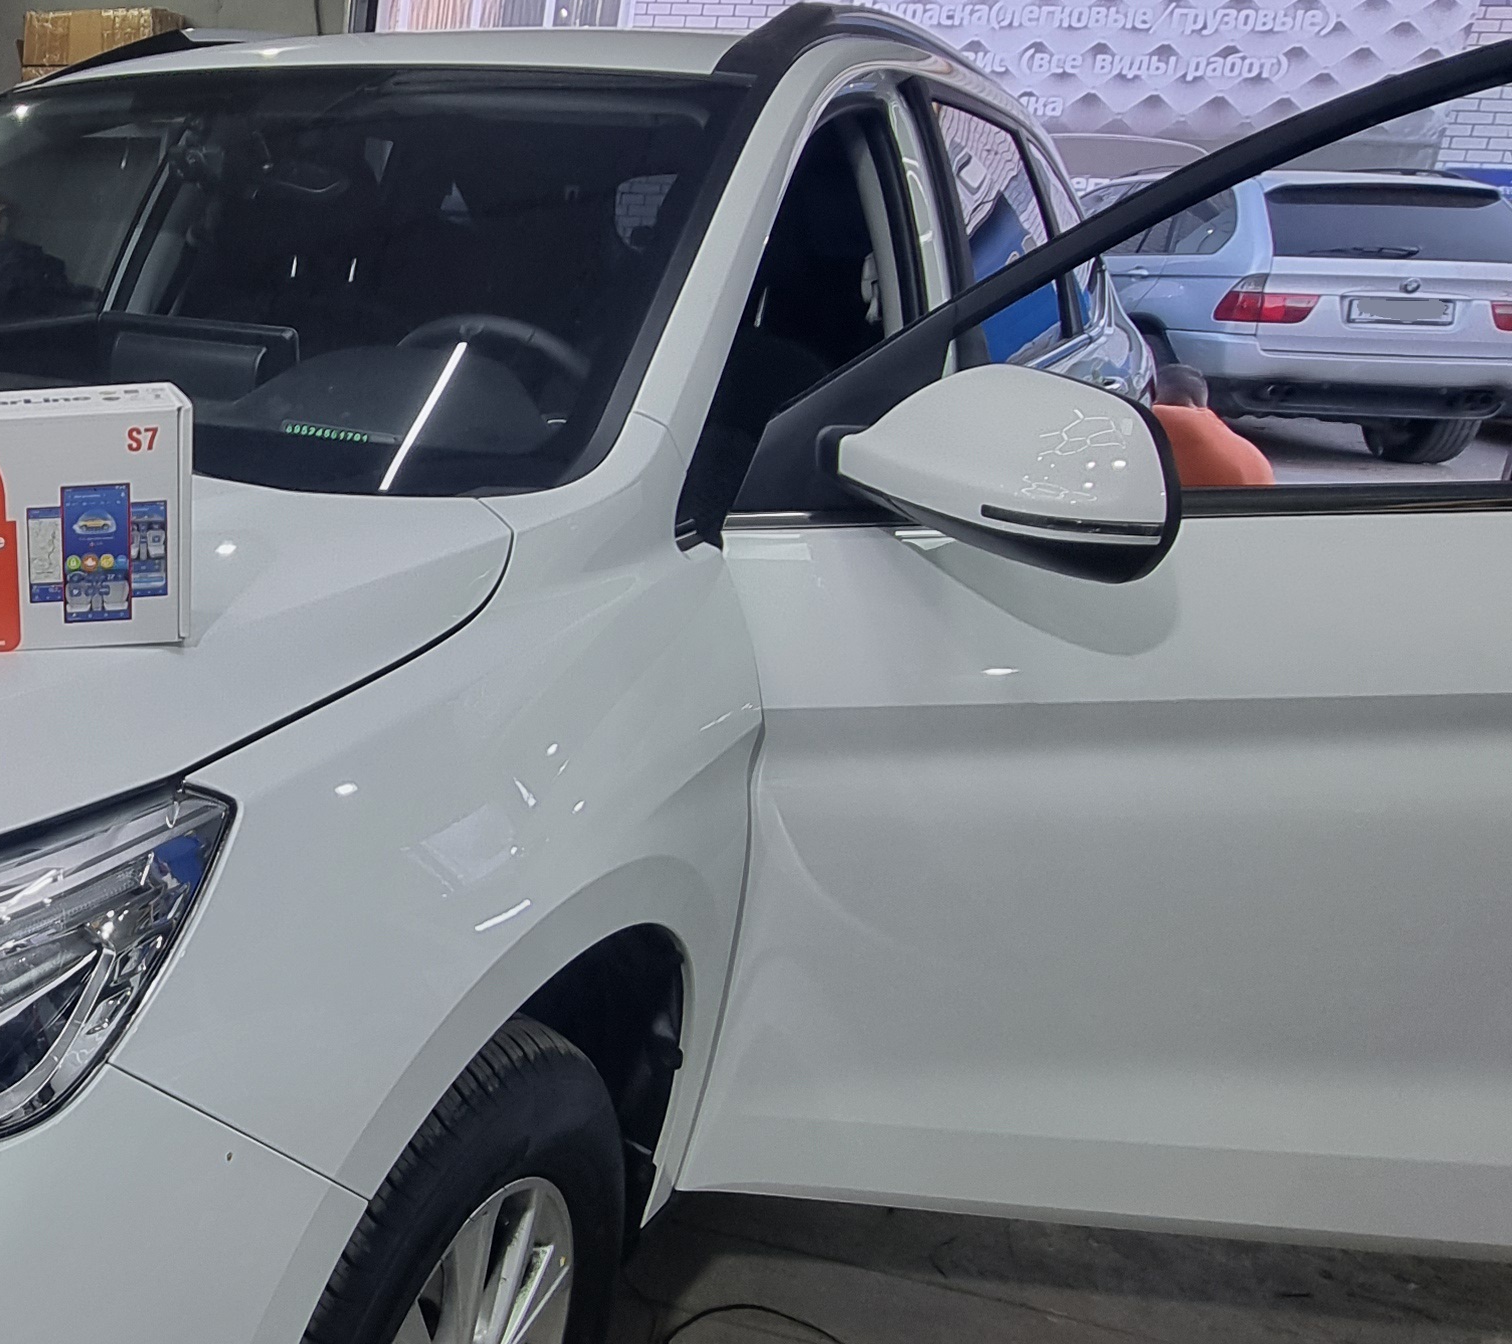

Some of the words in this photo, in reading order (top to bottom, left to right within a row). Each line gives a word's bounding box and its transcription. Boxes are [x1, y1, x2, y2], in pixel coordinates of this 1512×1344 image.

[1020, 47, 1082, 76] (все
[1094, 55, 1175, 79] виды
[1187, 53, 1288, 82] работ)
[127, 427, 159, 452] S7
